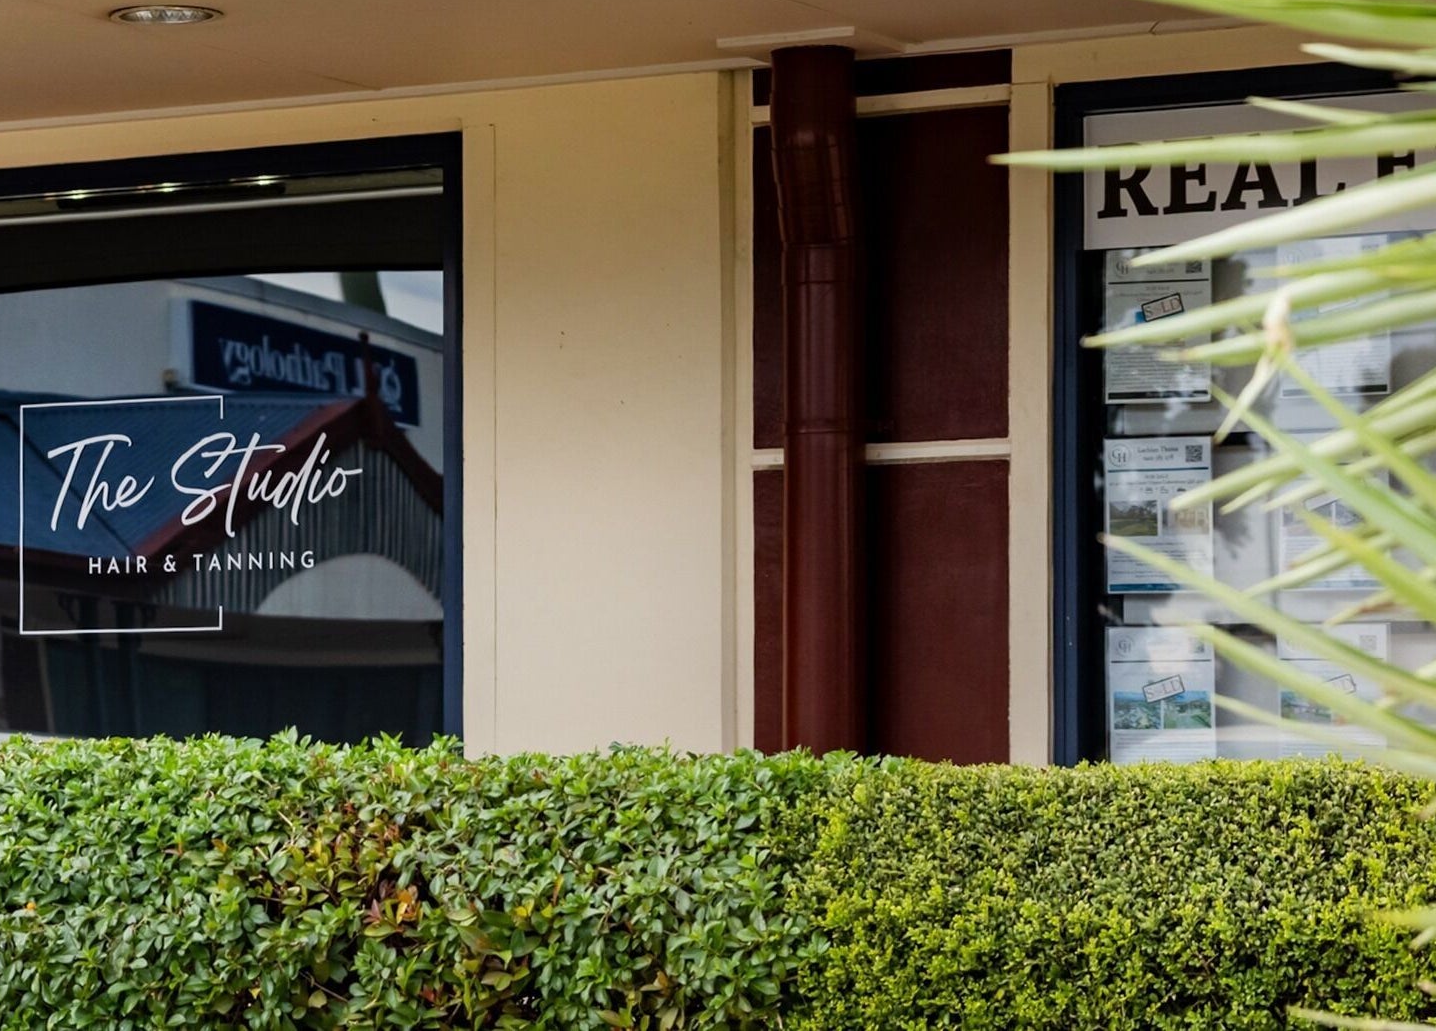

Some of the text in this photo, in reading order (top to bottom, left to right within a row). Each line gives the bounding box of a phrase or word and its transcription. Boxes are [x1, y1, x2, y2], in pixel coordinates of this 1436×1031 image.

[47, 432, 363, 538] The Studio
[89, 550, 314, 574] HAIR & TANNING
